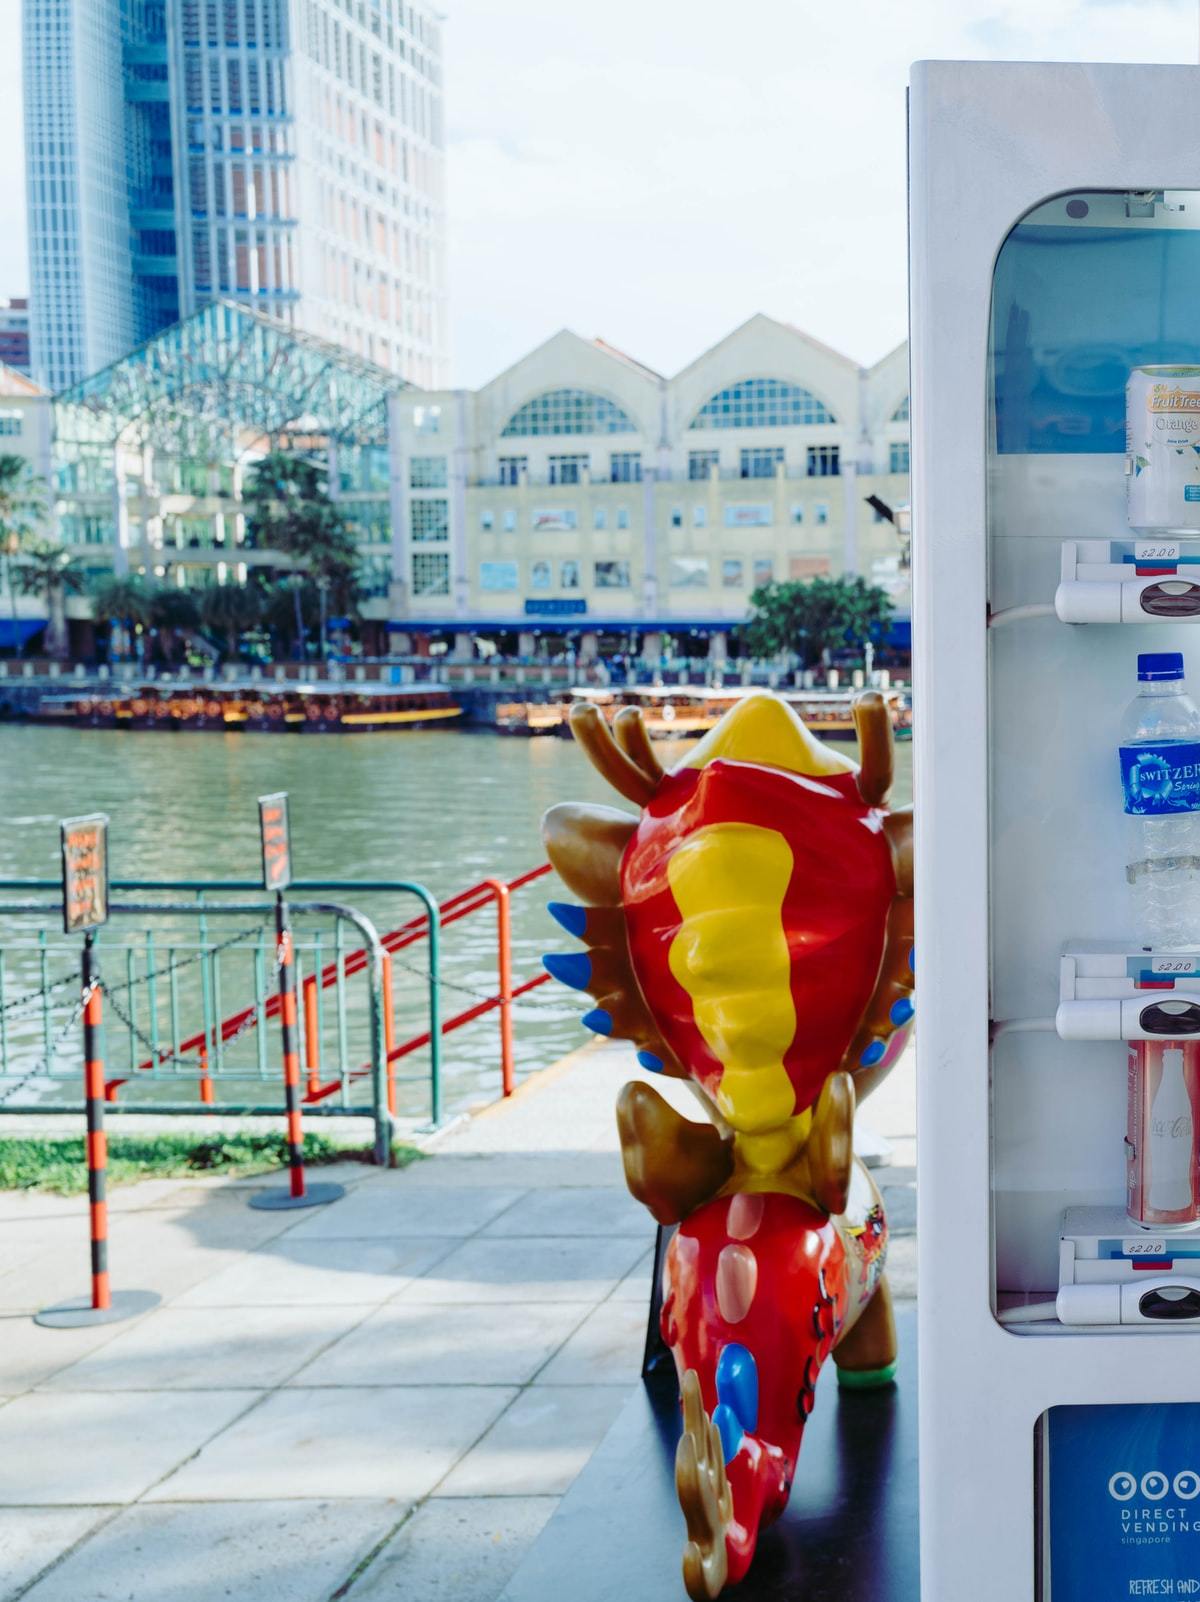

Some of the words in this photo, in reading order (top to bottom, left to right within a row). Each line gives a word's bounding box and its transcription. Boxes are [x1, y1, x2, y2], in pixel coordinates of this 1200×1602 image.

[1156, 417, 1199, 433] Orange
[1141, 548, 1175, 558] $2.00
[1173, 780, 1200, 793] Spring
[1158, 962, 1191, 972] $2.00
[1128, 1244, 1162, 1253] $2.00
[1121, 1508, 1187, 1520] DIRECT
[1121, 1535, 1171, 1545] singapore
[1129, 1578, 1174, 1595] REFRESH
[1176, 1579, 1200, 1594] AND
